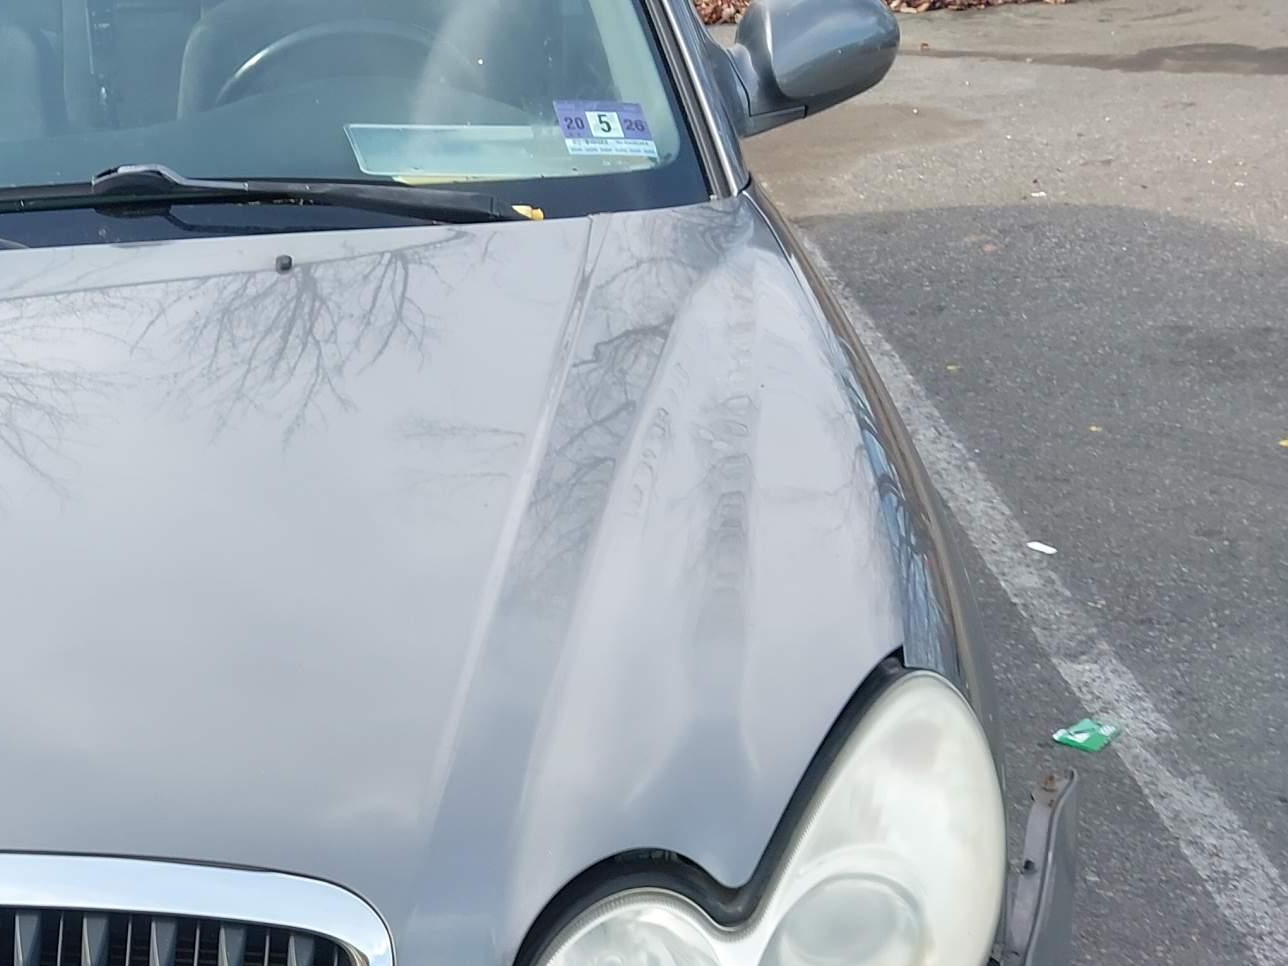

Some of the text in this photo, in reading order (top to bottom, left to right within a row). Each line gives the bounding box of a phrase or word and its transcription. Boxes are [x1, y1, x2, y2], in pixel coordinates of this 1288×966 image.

[564, 114, 645, 133] 20 5 26
